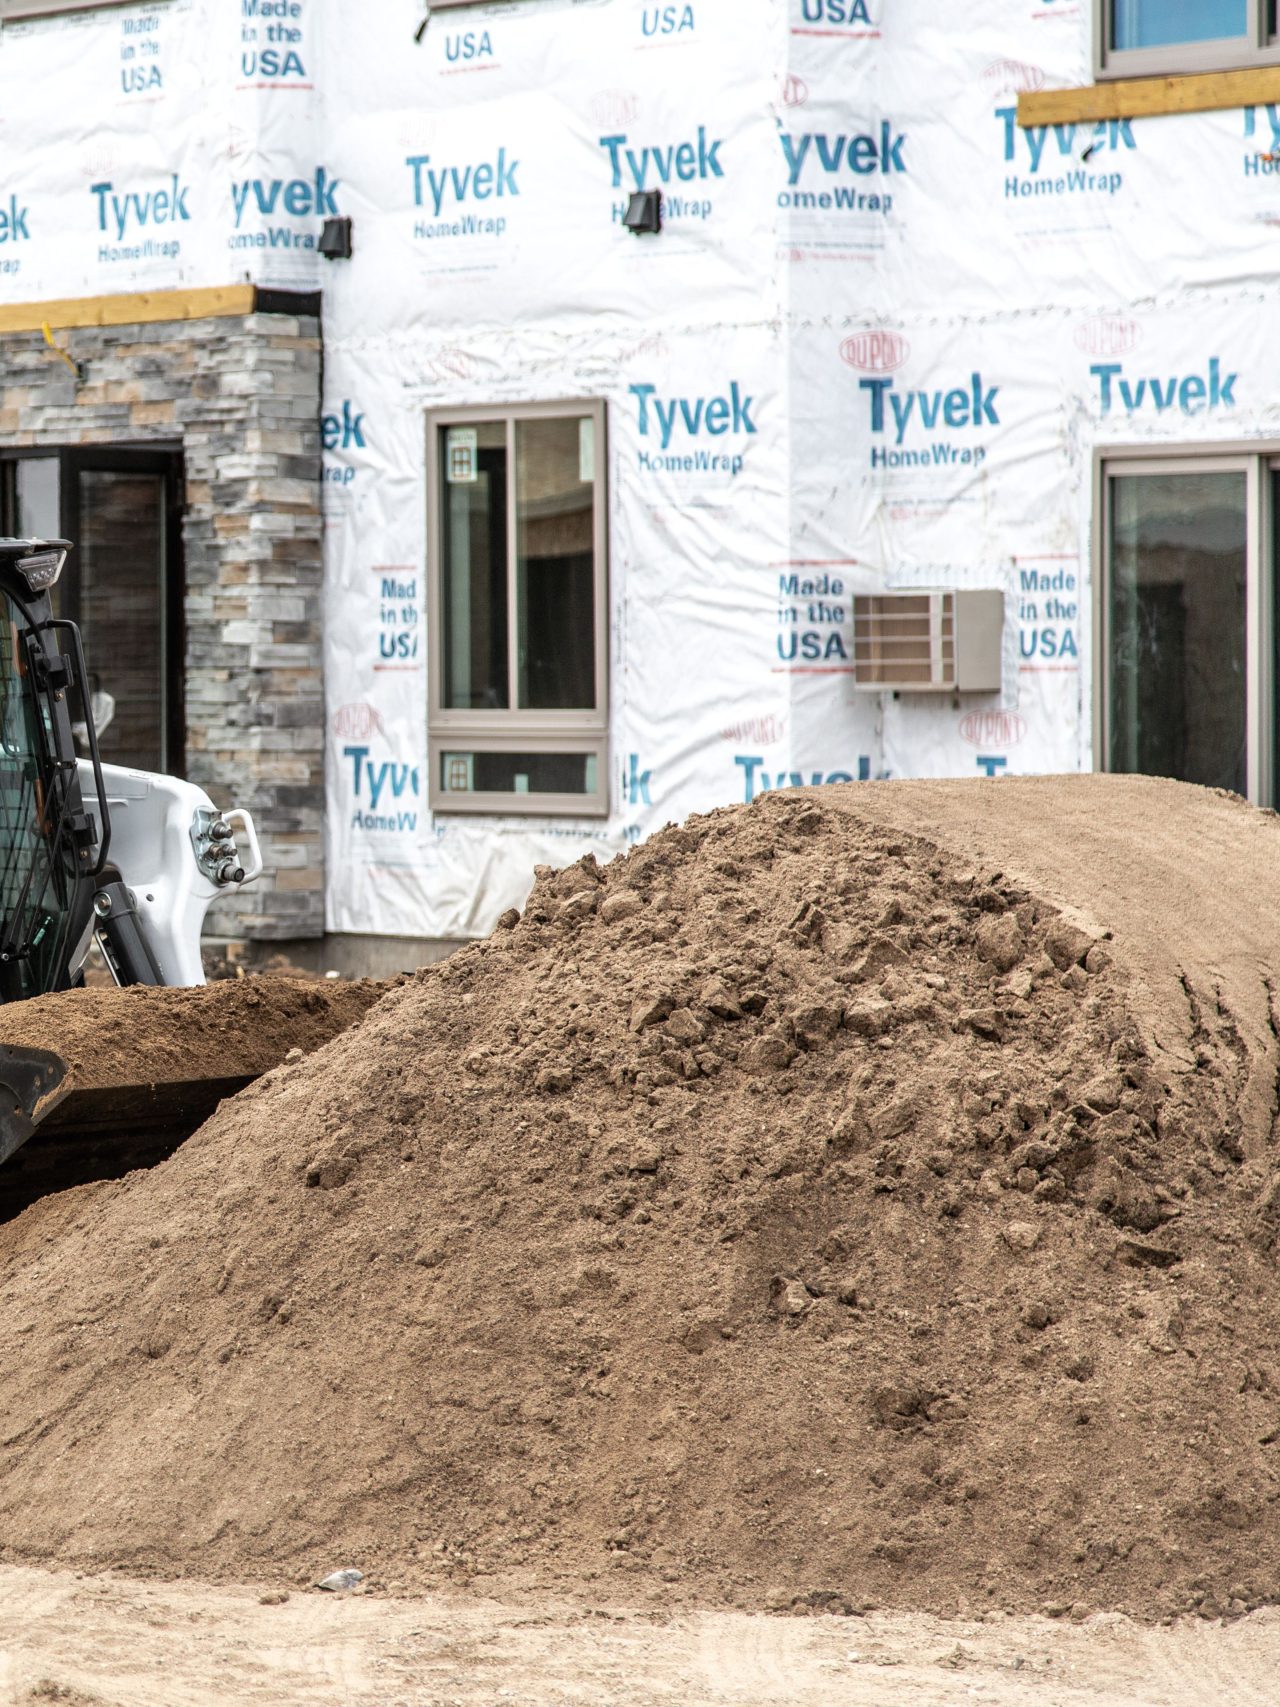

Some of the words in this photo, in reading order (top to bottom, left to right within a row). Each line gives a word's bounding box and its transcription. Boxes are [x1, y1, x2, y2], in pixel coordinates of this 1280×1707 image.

[242, 0, 301, 18] Made
[641, 5, 694, 36] USA
[802, 0, 871, 25] USA
[268, 22, 302, 43] the
[445, 31, 493, 62] USA
[242, 51, 304, 77] USA
[122, 65, 163, 93] USA
[600, 126, 724, 192] Tyvek
[777, 119, 906, 185] yvek
[406, 148, 520, 216] Tyvek
[1005, 171, 1122, 198] HomeWrap
[91, 174, 191, 241] Tyvek
[232, 167, 341, 227] yvek
[777, 187, 892, 214] omeWrap
[612, 197, 712, 224] HeWrap
[228, 228, 317, 250] omeWra
[414, 216, 506, 239] HomeWrap
[97, 240, 180, 263] HomeWrap
[629, 381, 757, 450] Tyvek
[859, 372, 1000, 444] Tyvek
[638, 451, 743, 476] HomeWrap
[871, 443, 986, 469] HomeWrap
[381, 578, 417, 600] Mad
[778, 573, 844, 596] Made
[1020, 570, 1075, 592] Made
[380, 604, 396, 624] in
[401, 604, 417, 625] th
[778, 602, 797, 624] in
[808, 601, 844, 624] the
[1020, 598, 1038, 619] in
[1046, 598, 1076, 619] the
[777, 630, 847, 660] USA
[1020, 629, 1077, 657] USA
[352, 812, 417, 832] HomeW
